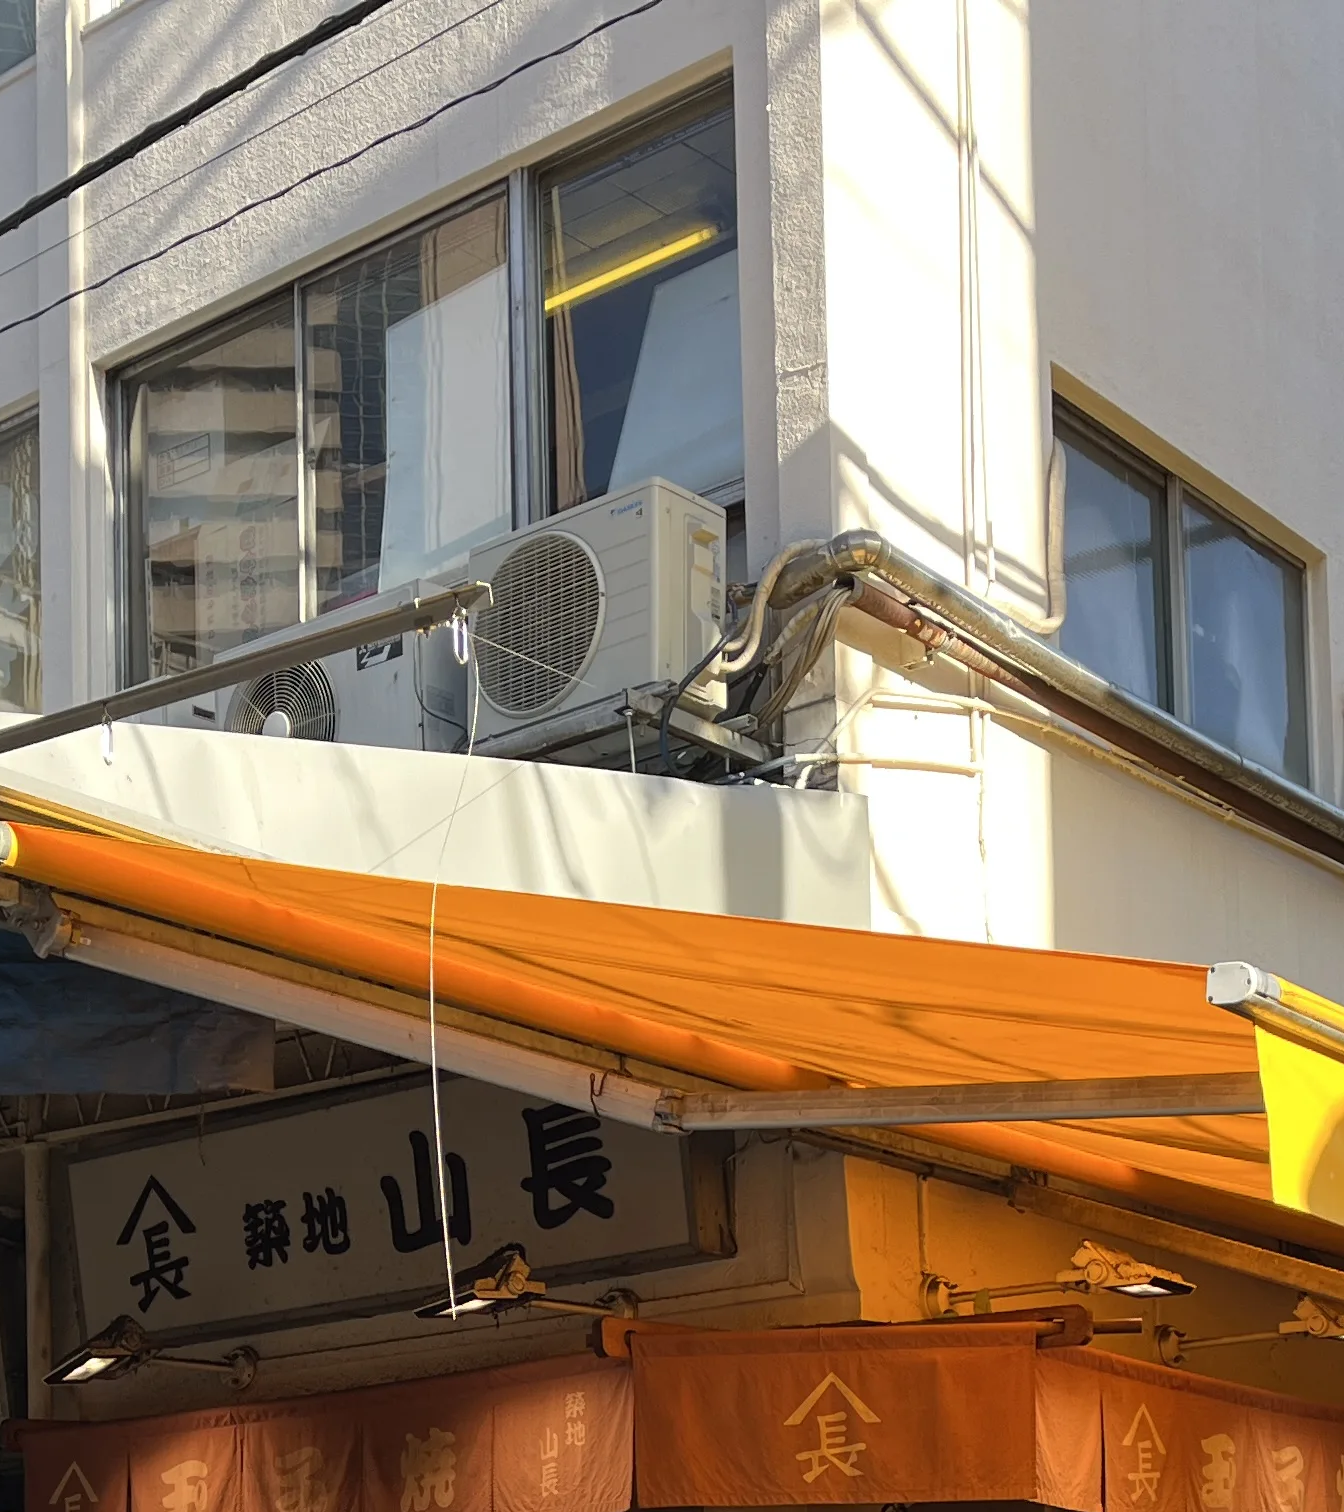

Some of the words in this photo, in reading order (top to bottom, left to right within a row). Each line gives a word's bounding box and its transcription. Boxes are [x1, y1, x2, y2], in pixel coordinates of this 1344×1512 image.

[243, 1186, 351, 1270] 築地
[379, 1102, 615, 1254] 山長
[564, 1391, 586, 1446] 築地
[539, 1426, 559, 1498] 山長
